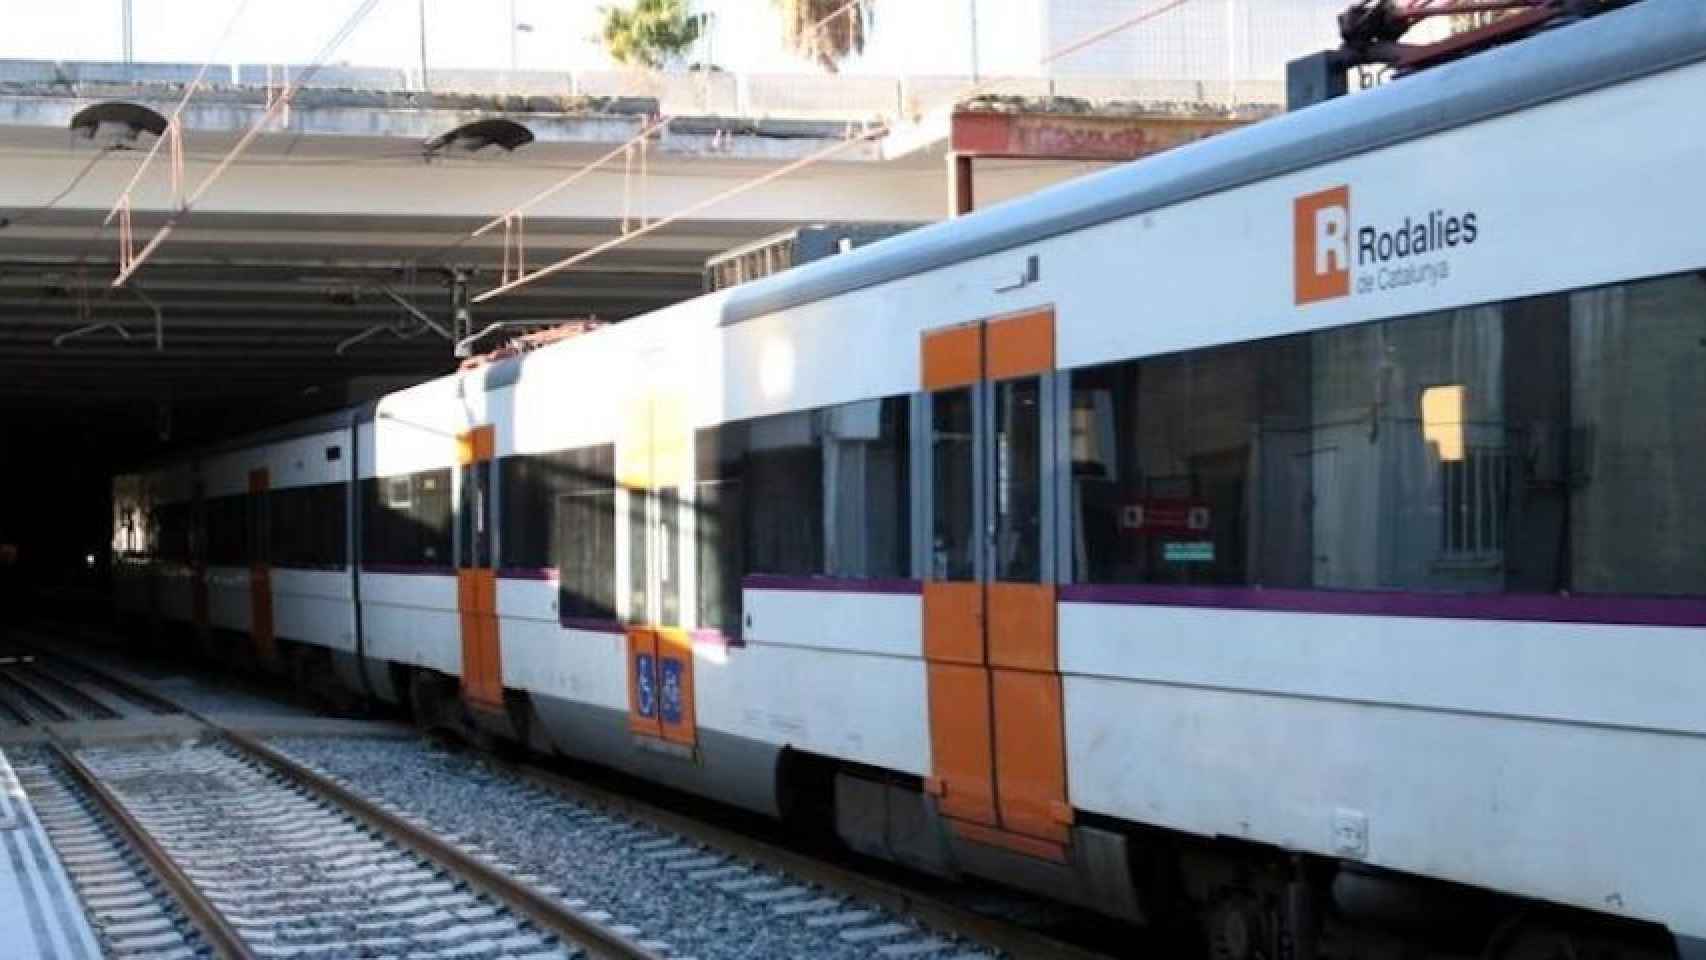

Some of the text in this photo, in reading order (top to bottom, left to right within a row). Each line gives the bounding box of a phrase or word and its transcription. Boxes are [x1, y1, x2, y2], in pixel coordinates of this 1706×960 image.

[1315, 206, 1349, 275] R
[1358, 209, 1477, 264] Rodalies
[1357, 260, 1449, 293] de Catalunya
